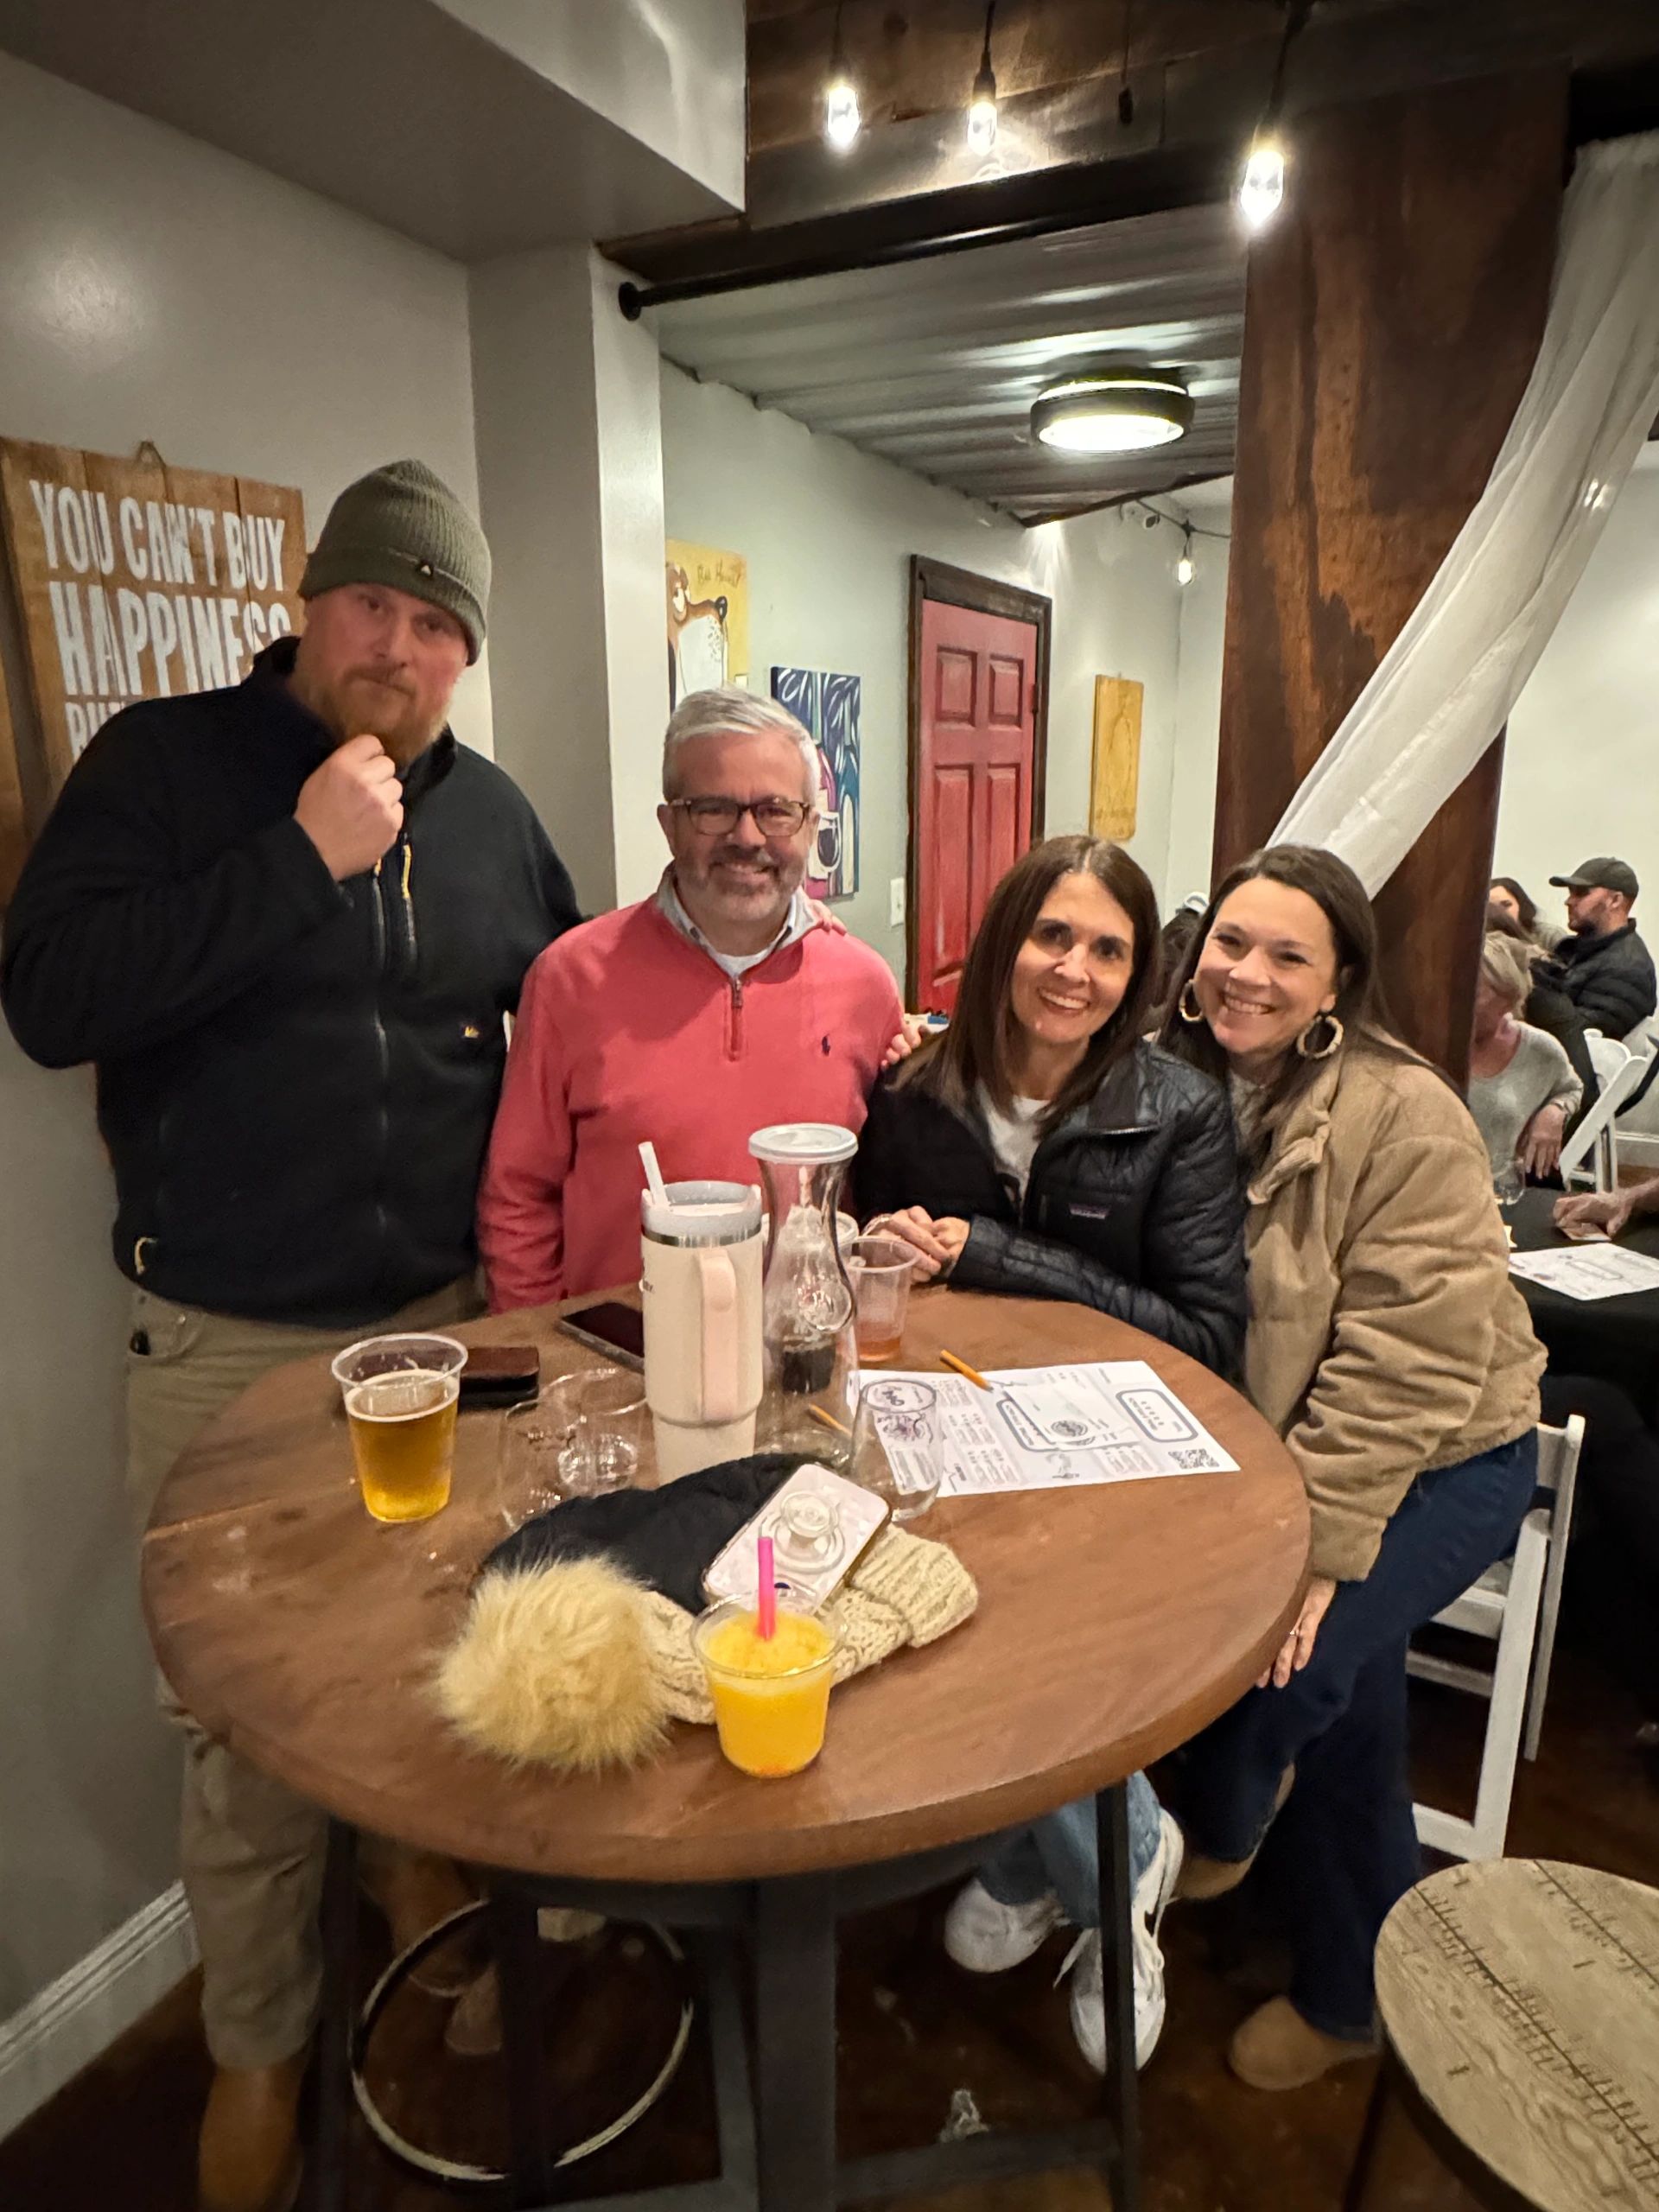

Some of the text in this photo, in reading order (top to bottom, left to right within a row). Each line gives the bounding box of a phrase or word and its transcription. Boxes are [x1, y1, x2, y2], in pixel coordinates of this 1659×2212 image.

[29, 480, 285, 592] YOU CAN'T BUY
